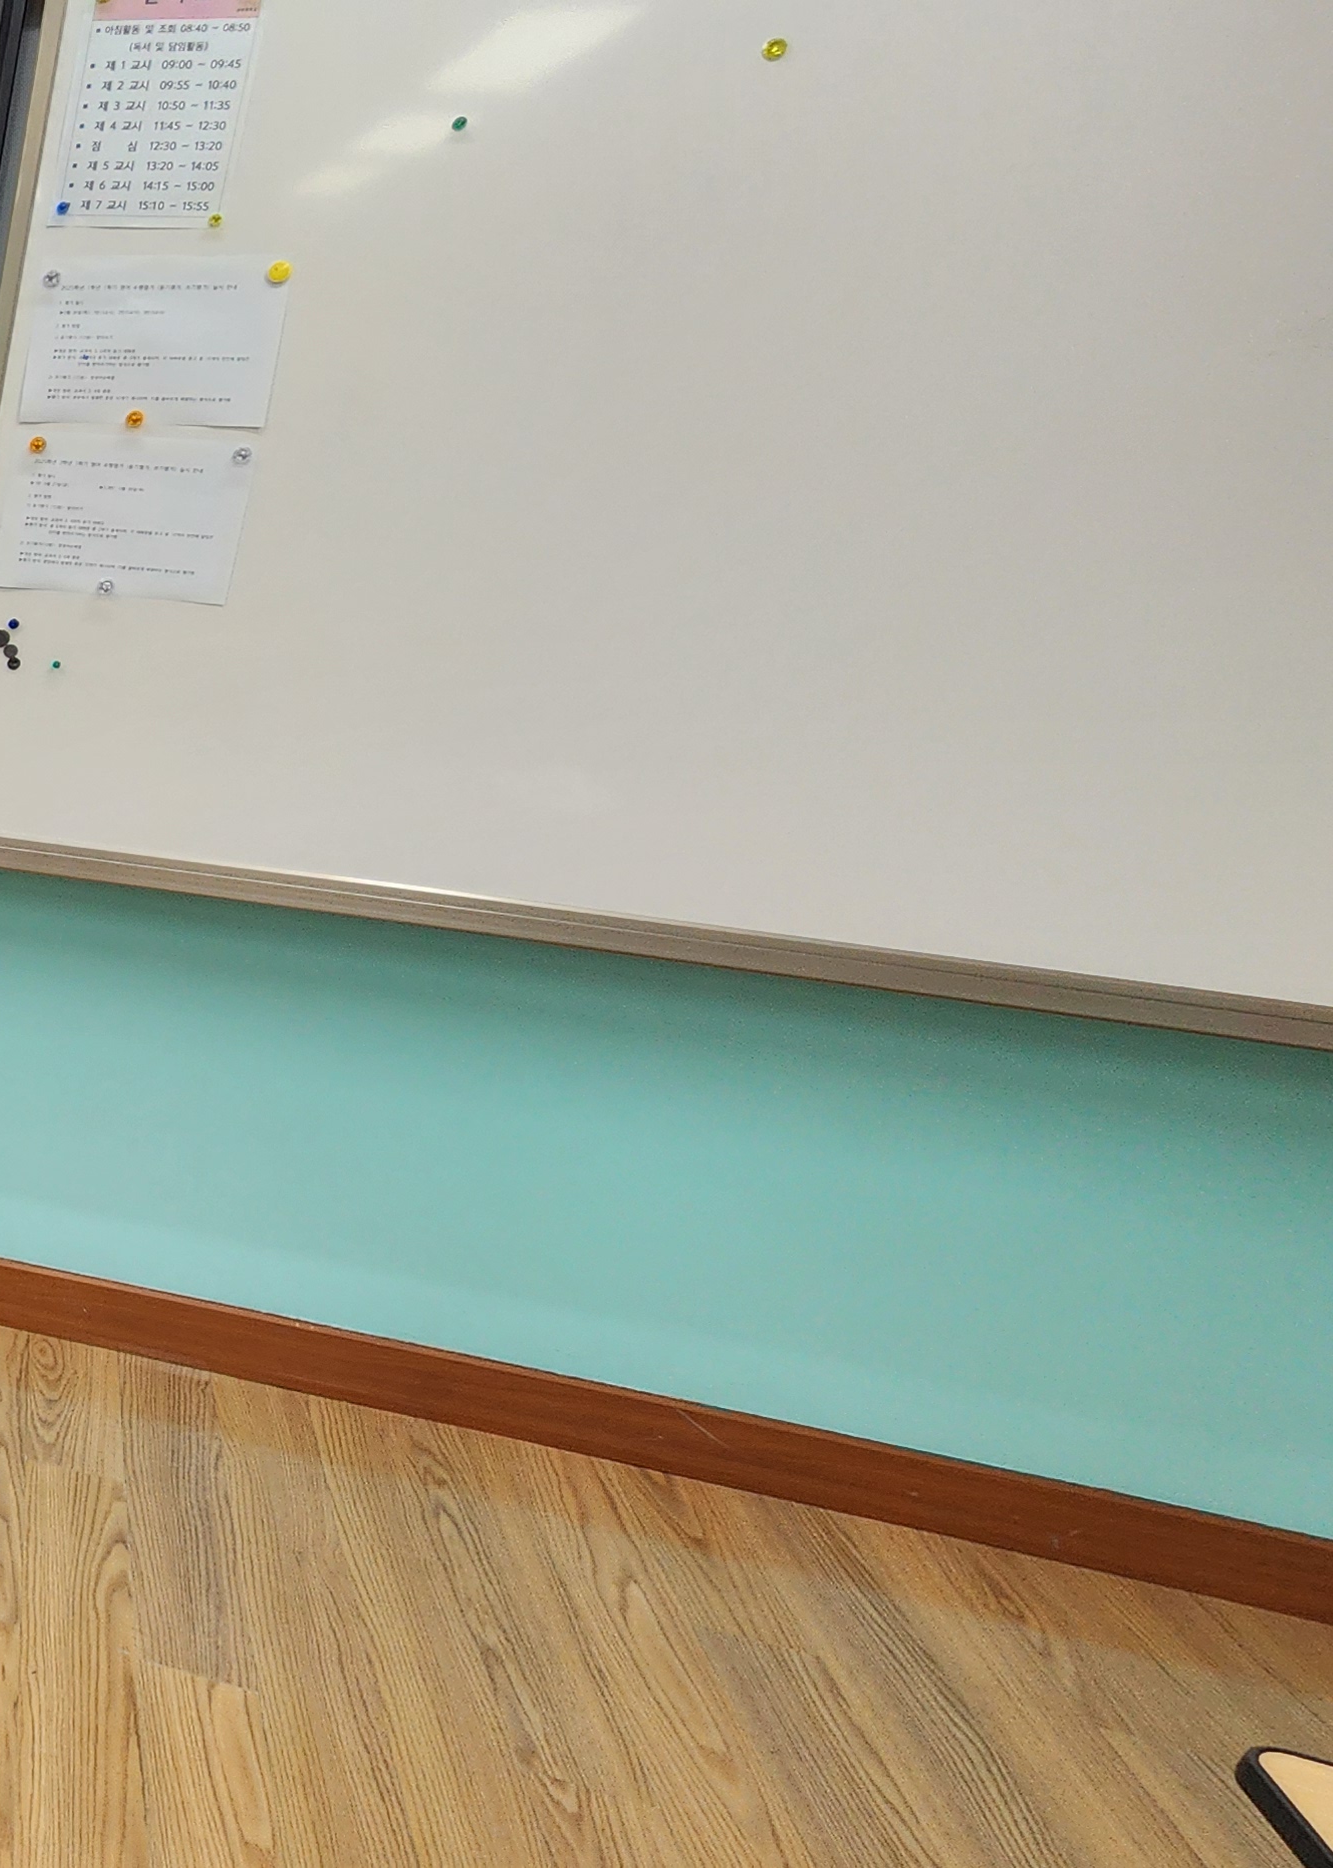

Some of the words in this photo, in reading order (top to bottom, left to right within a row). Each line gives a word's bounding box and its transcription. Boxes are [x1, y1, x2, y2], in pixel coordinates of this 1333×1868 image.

[105, 60, 117, 71] 제
[121, 60, 126, 69] 1
[131, 60, 152, 71] 교시
[161, 60, 193, 69] 09:00
[210, 59, 242, 69] 09:45
[101, 80, 113, 92] 제
[116, 81, 124, 91] 2
[128, 80, 150, 91] 교시
[159, 80, 190, 90] 09:55
[208, 80, 237, 90] 10:40
[98, 101, 109, 112] 제
[113, 102, 120, 111] 3
[124, 100, 146, 111] 교시
[158, 101, 186, 110] 10:50
[203, 101, 231, 110] 11:35
[94, 121, 105, 132] 제
[110, 121, 116, 130] 4
[121, 121, 143, 132] 교시
[154, 121, 181, 131] 11:45
[198, 121, 226, 131] 12:30
[91, 140, 102, 152] 점
[128, 140, 138, 152] 심
[150, 141, 177, 151] 12:30
[195, 141, 223, 151] 13:20
[87, 161, 98, 172] 제
[102, 162, 109, 171] 5
[114, 160, 135, 172] 교시
[146, 161, 174, 171] 13:20
[191, 161, 220, 171] 14:05
[83, 180, 95, 191] 제
[99, 181, 106, 190] 6
[110, 180, 132, 191] 교시
[143, 181, 169, 191] 14:15
[186, 181, 215, 191] 15:00
[80, 200, 91, 211] 제
[95, 201, 103, 210] 7
[106, 200, 127, 211] 교시
[138, 201, 165, 211] 15:10
[183, 201, 210, 211] 15:55
